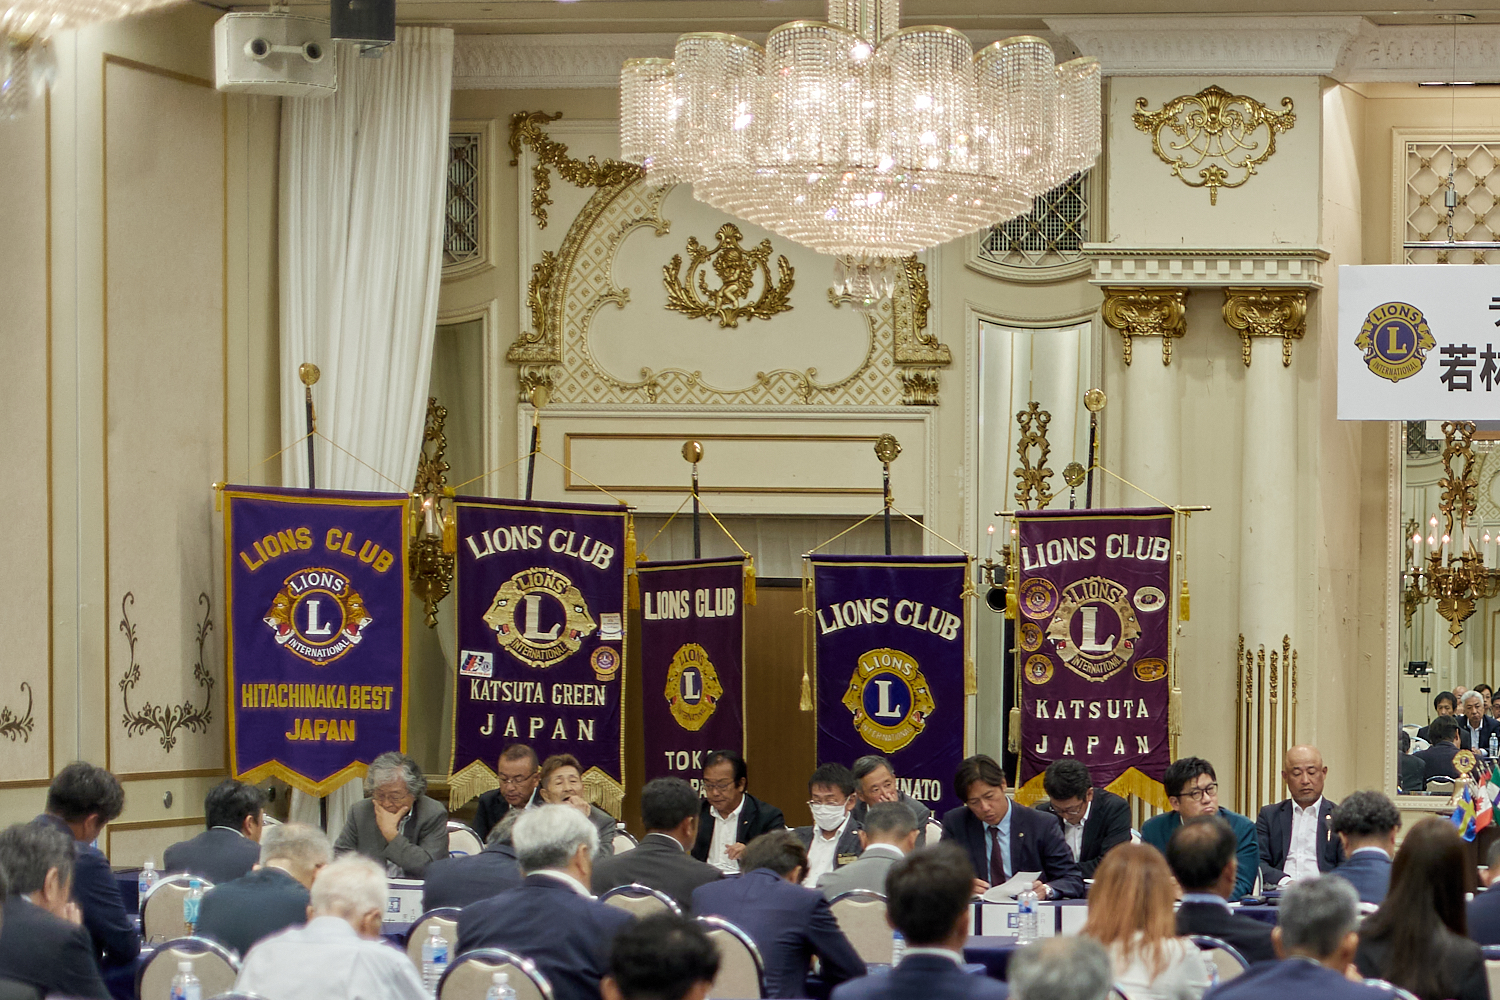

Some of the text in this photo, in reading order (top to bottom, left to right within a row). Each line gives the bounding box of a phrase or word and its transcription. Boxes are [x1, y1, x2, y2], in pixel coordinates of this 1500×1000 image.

[1372, 304, 1419, 322] LIONS
[1386, 326, 1408, 354] L
[1372, 361, 1419, 376] INTERNATIONAL
[240, 527, 394, 573] LIONS CLUB
[465, 525, 615, 570] LIONS CLUB
[1021, 533, 1171, 571] LIONS CLUB
[289, 572, 344, 593] LIONS
[517, 572, 567, 594] LIONS
[1070, 581, 1121, 604] LIONS
[305, 600, 331, 635] L
[523, 594, 561, 640] L
[644, 587, 736, 620] LIONS CLUB
[816, 597, 961, 641] LIONS CLUB
[1079, 606, 1116, 651] L
[288, 638, 350, 658] INTERNATIONAL
[510, 638, 568, 660] INTERNATIONAL
[862, 654, 913, 676] LIONS
[1070, 655, 1123, 674] INTERNATIONAL
[241, 683, 394, 711] HITACHINAKA BEST
[470, 678, 607, 706] KATSUTA GREEN
[682, 671, 700, 700] L
[874, 680, 901, 718] L
[1036, 698, 1149, 719] KATSUTA
[285, 718, 355, 742] JAPAN
[480, 713, 595, 741] JAPAN
[1035, 735, 1150, 756] JAPAN
[665, 750, 713, 771] TOK
